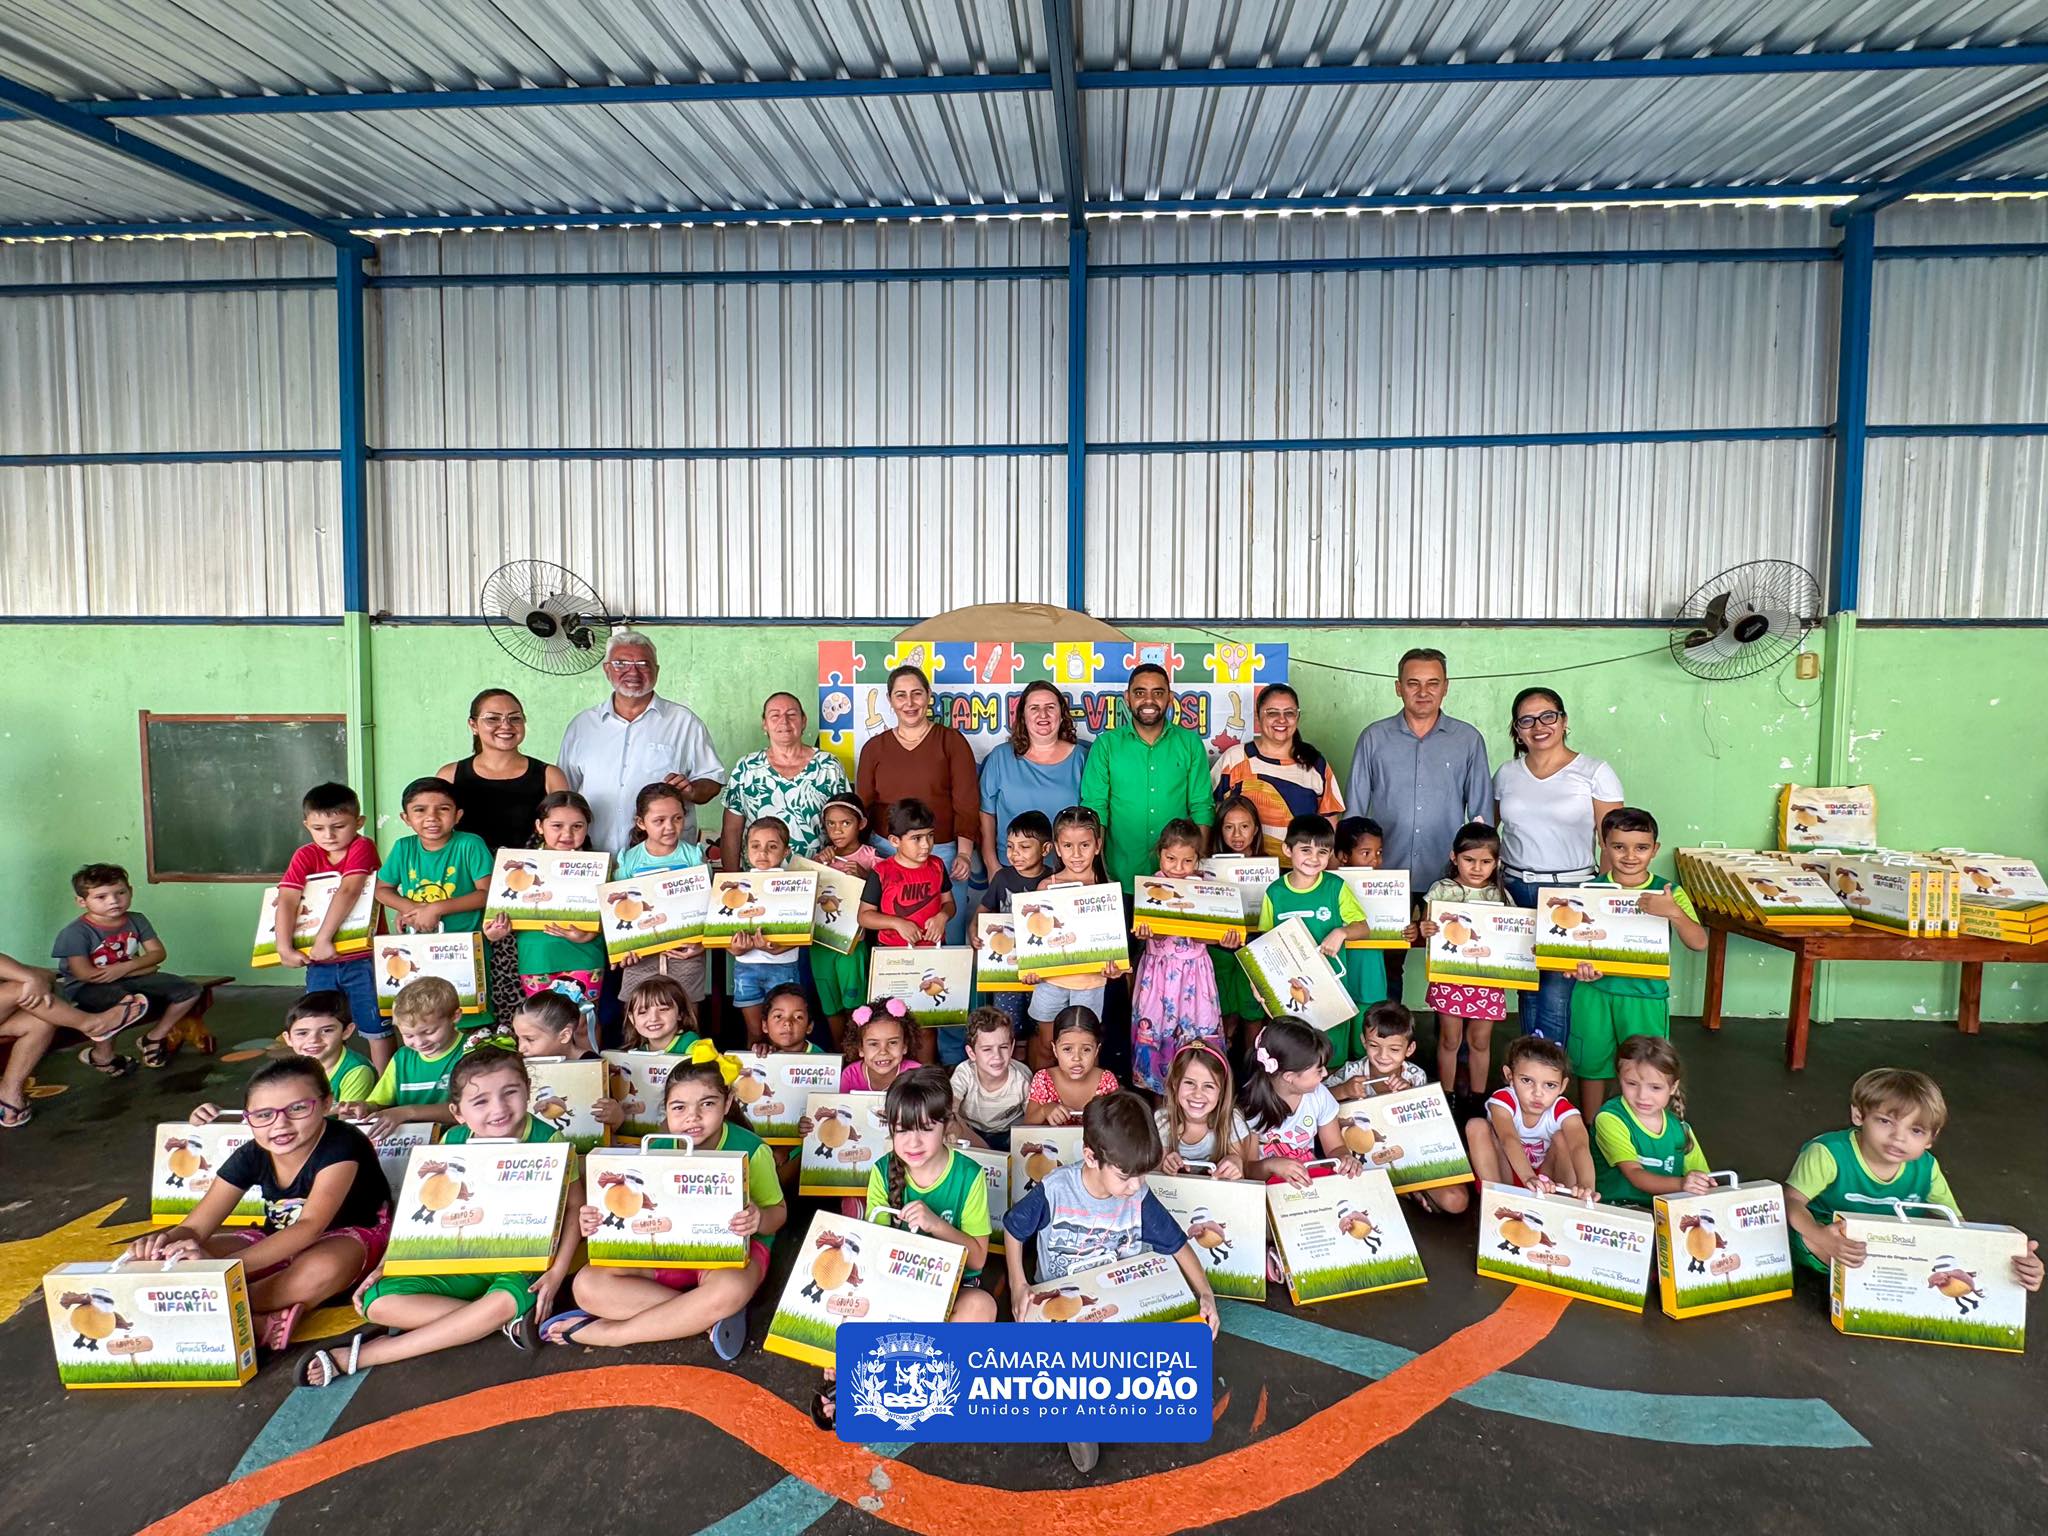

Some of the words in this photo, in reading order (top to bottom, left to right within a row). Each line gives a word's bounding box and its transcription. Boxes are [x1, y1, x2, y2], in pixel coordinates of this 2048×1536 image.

[559, 861, 604, 871] EDUCAÇÃO
[560, 869, 600, 878] INFANTIL
[662, 875, 706, 890] EDUCAÇÃO
[770, 878, 813, 888] EDUCAÇÃO
[1361, 879, 1405, 890] EDUCAÇÃO
[666, 884, 705, 897] INFANTIL
[901, 881, 932, 902] NIKE
[1364, 888, 1403, 897] INFANTIL
[1073, 894, 1118, 907] EDUCAÇÃO
[1608, 899, 1640, 907] EDUC
[1076, 904, 1117, 915] INFANTIL
[1611, 906, 1648, 915] INFAN
[430, 943, 470, 953] EDUCAÇÃO
[788, 1066, 836, 1077] EDUCAÇÃO
[790, 1077, 833, 1086] INFANTIL
[1391, 1097, 1441, 1115] EDUCAÇÃO
[1397, 1109, 1443, 1125] INFANTIL
[496, 1156, 559, 1170] EDUCAÇÃO
[497, 1170, 553, 1182] INFANTIL
[674, 1172, 735, 1186] EDUCAÇÃO
[677, 1185, 733, 1196] INFANTIL
[1735, 1200, 1780, 1217] EDUCAÇÃO
[1739, 1214, 1781, 1229] INFANTIL
[1576, 1223, 1646, 1244] EDUCAÇÃO
[1579, 1232, 1641, 1253] INFANTIL
[889, 1248, 951, 1273] EDUCAÇÃO
[888, 1261, 943, 1287] INFANTIL
[1107, 1256, 1167, 1280] EDUCAÇÃO
[1114, 1264, 1169, 1286] INFANTIL
[148, 1288, 218, 1302] EDUCAÇÃO
[154, 1302, 218, 1313] INFANTIL
